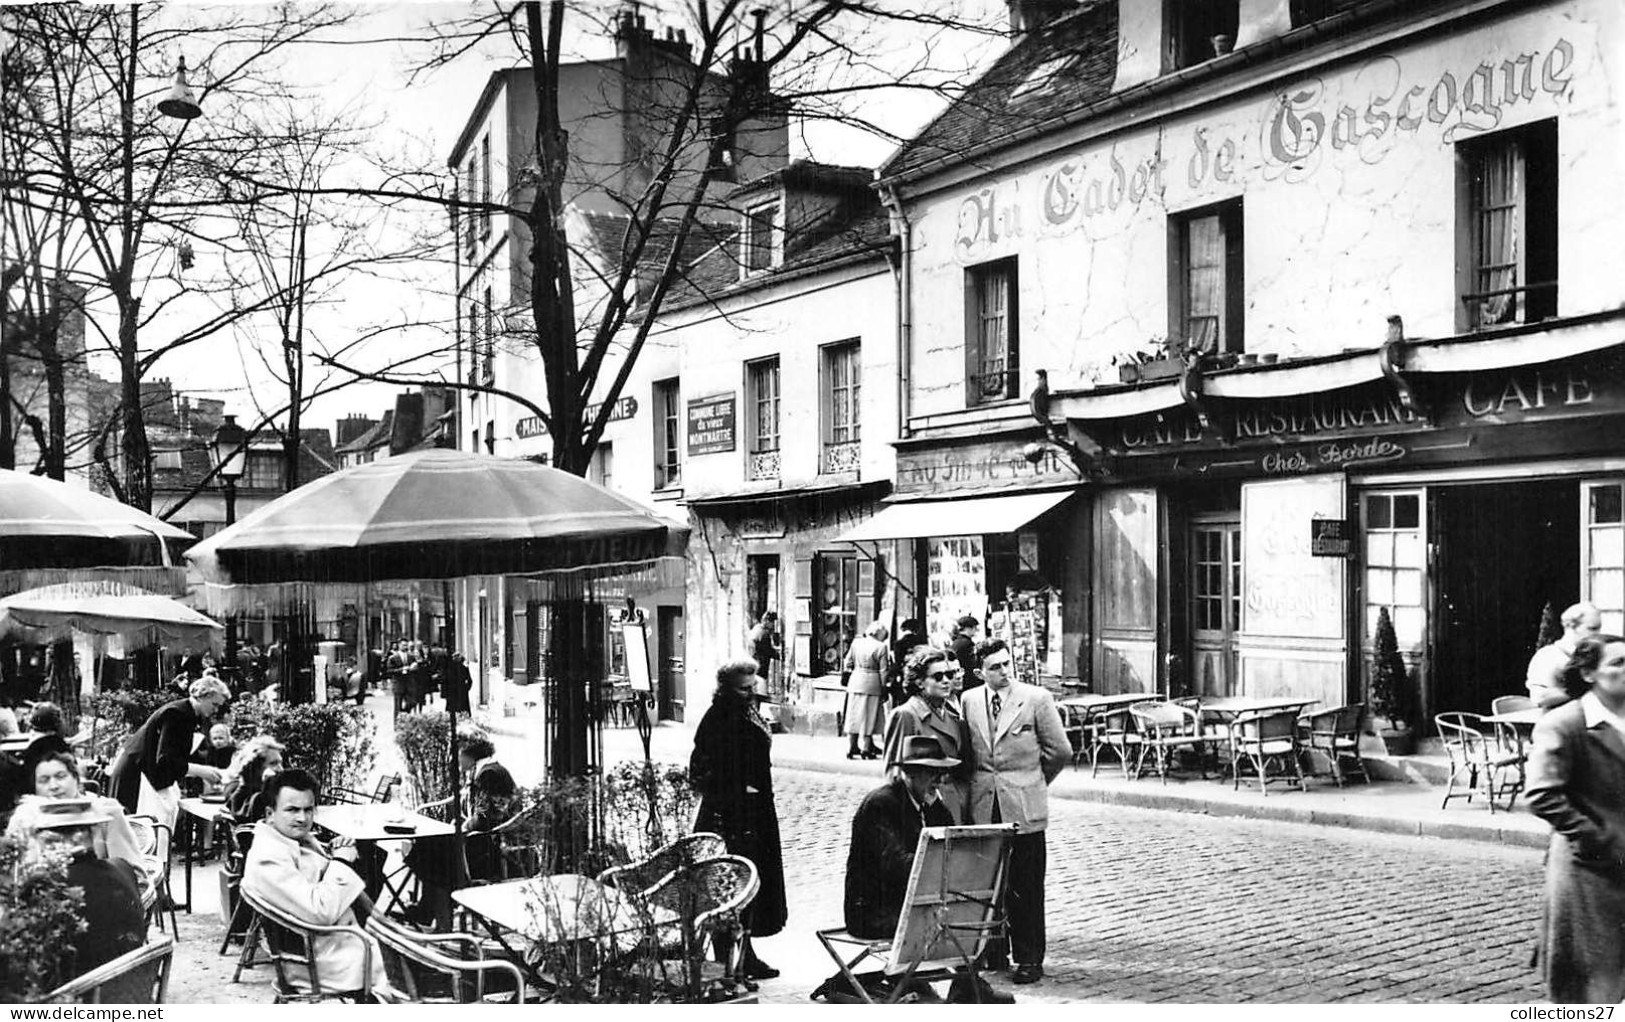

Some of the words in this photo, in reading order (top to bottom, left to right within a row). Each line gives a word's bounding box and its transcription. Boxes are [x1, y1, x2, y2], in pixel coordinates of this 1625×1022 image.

[1043, 140, 1168, 225] Cadet
[1187, 126, 1236, 189] de
[1264, 38, 1574, 168] Gascogne
[716, 402, 731, 417] LIBRE
[689, 428, 731, 445] MONTMARTRE
